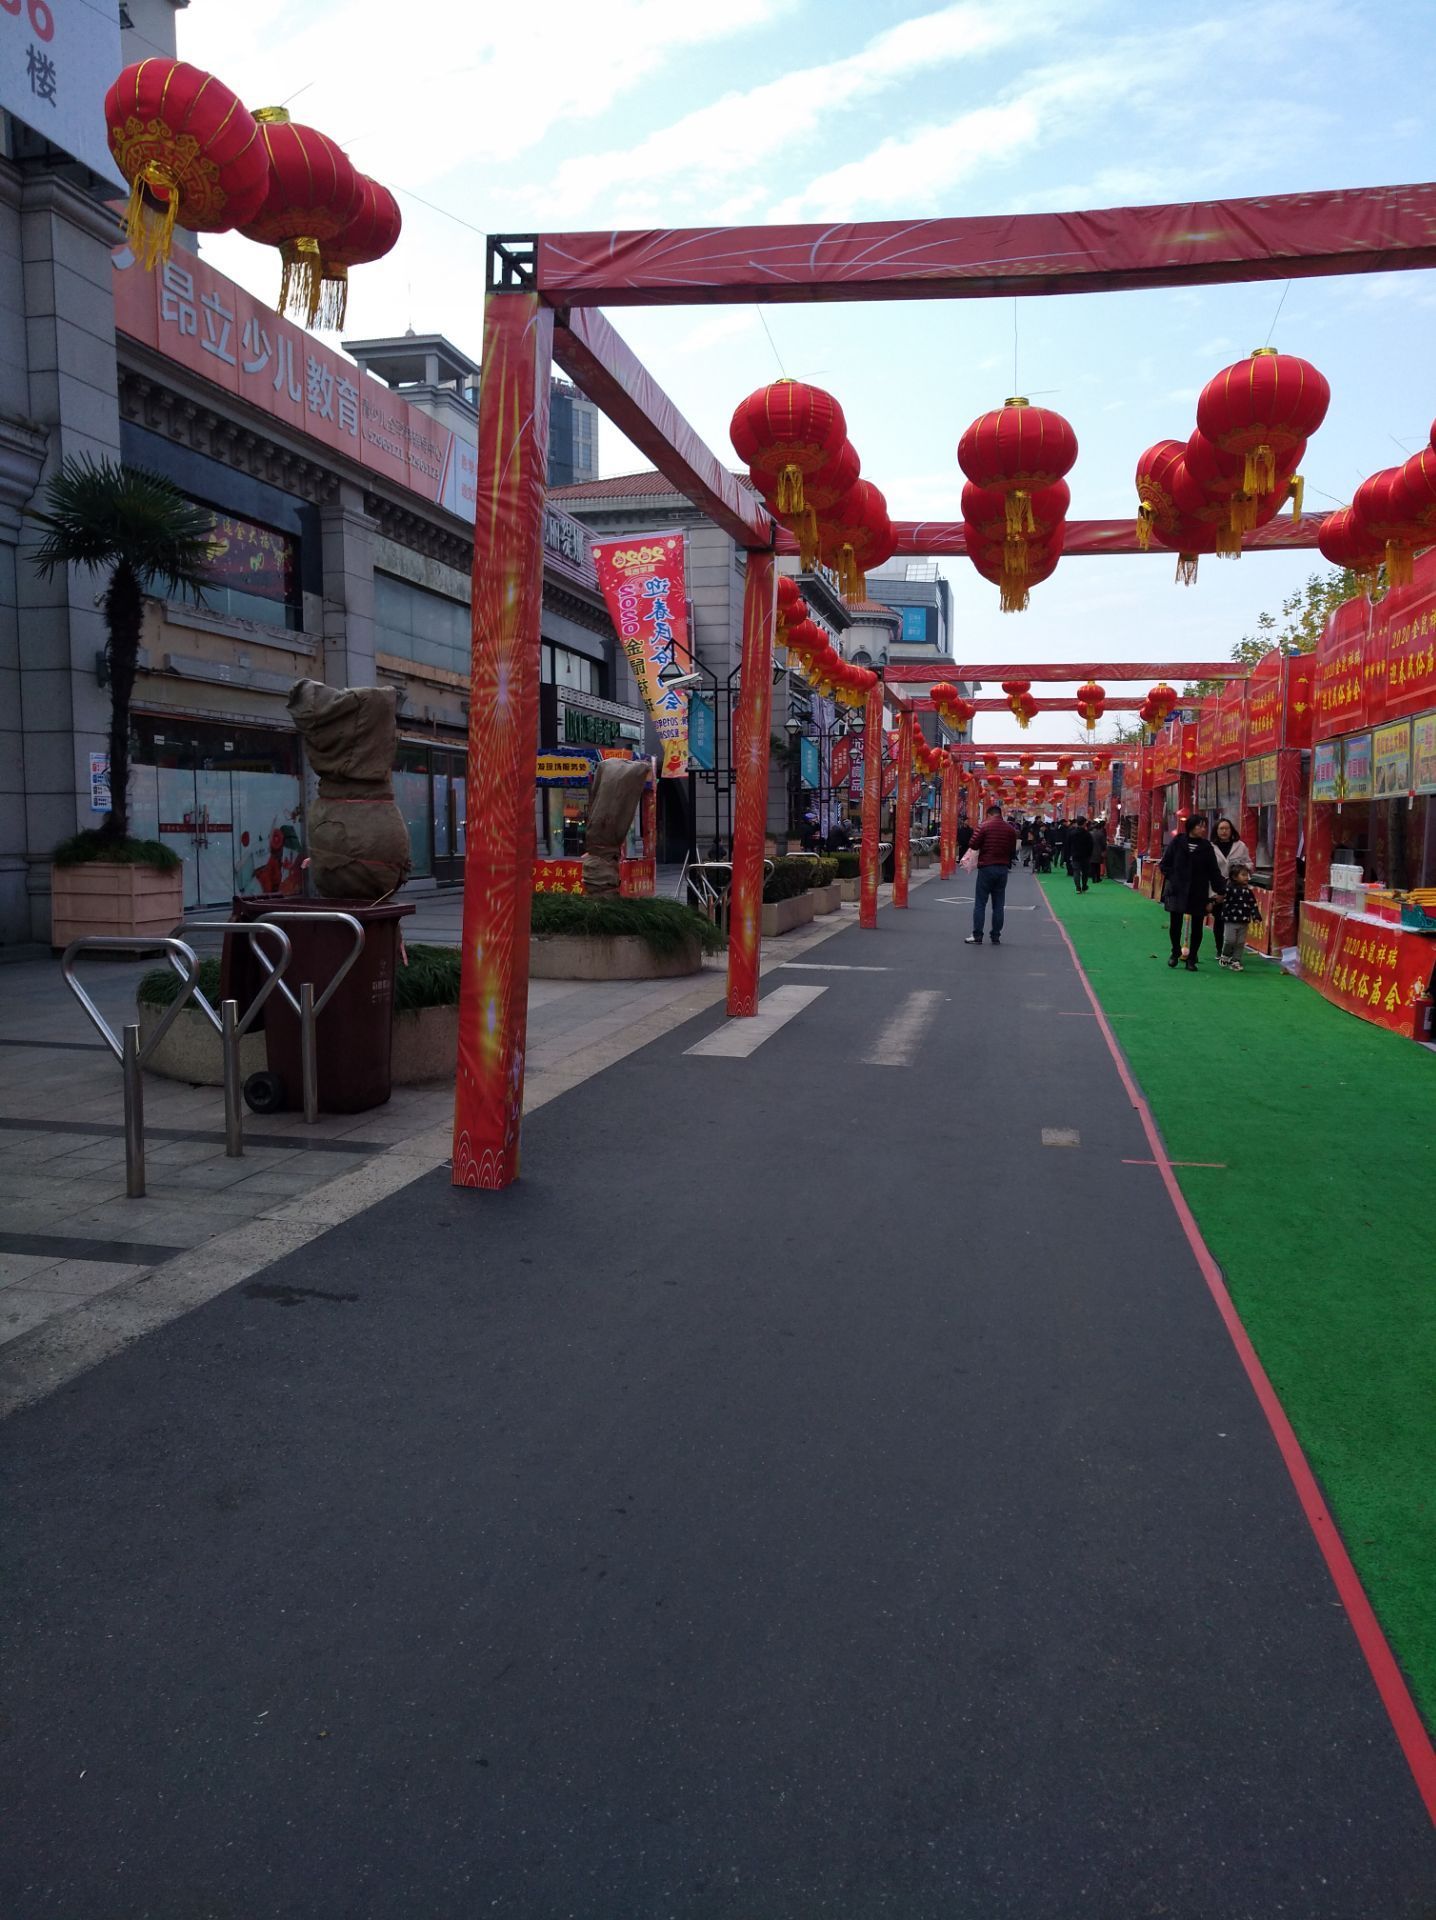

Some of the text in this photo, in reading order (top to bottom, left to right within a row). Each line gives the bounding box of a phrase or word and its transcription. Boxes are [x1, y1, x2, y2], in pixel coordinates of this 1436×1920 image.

[26, 43, 57, 107] 楼
[161, 261, 359, 437] 昂立少儿教育
[1343, 935, 1399, 970] 2020金鼠祥瑞
[1332, 963, 1401, 1013] 迎春民俗庙会
